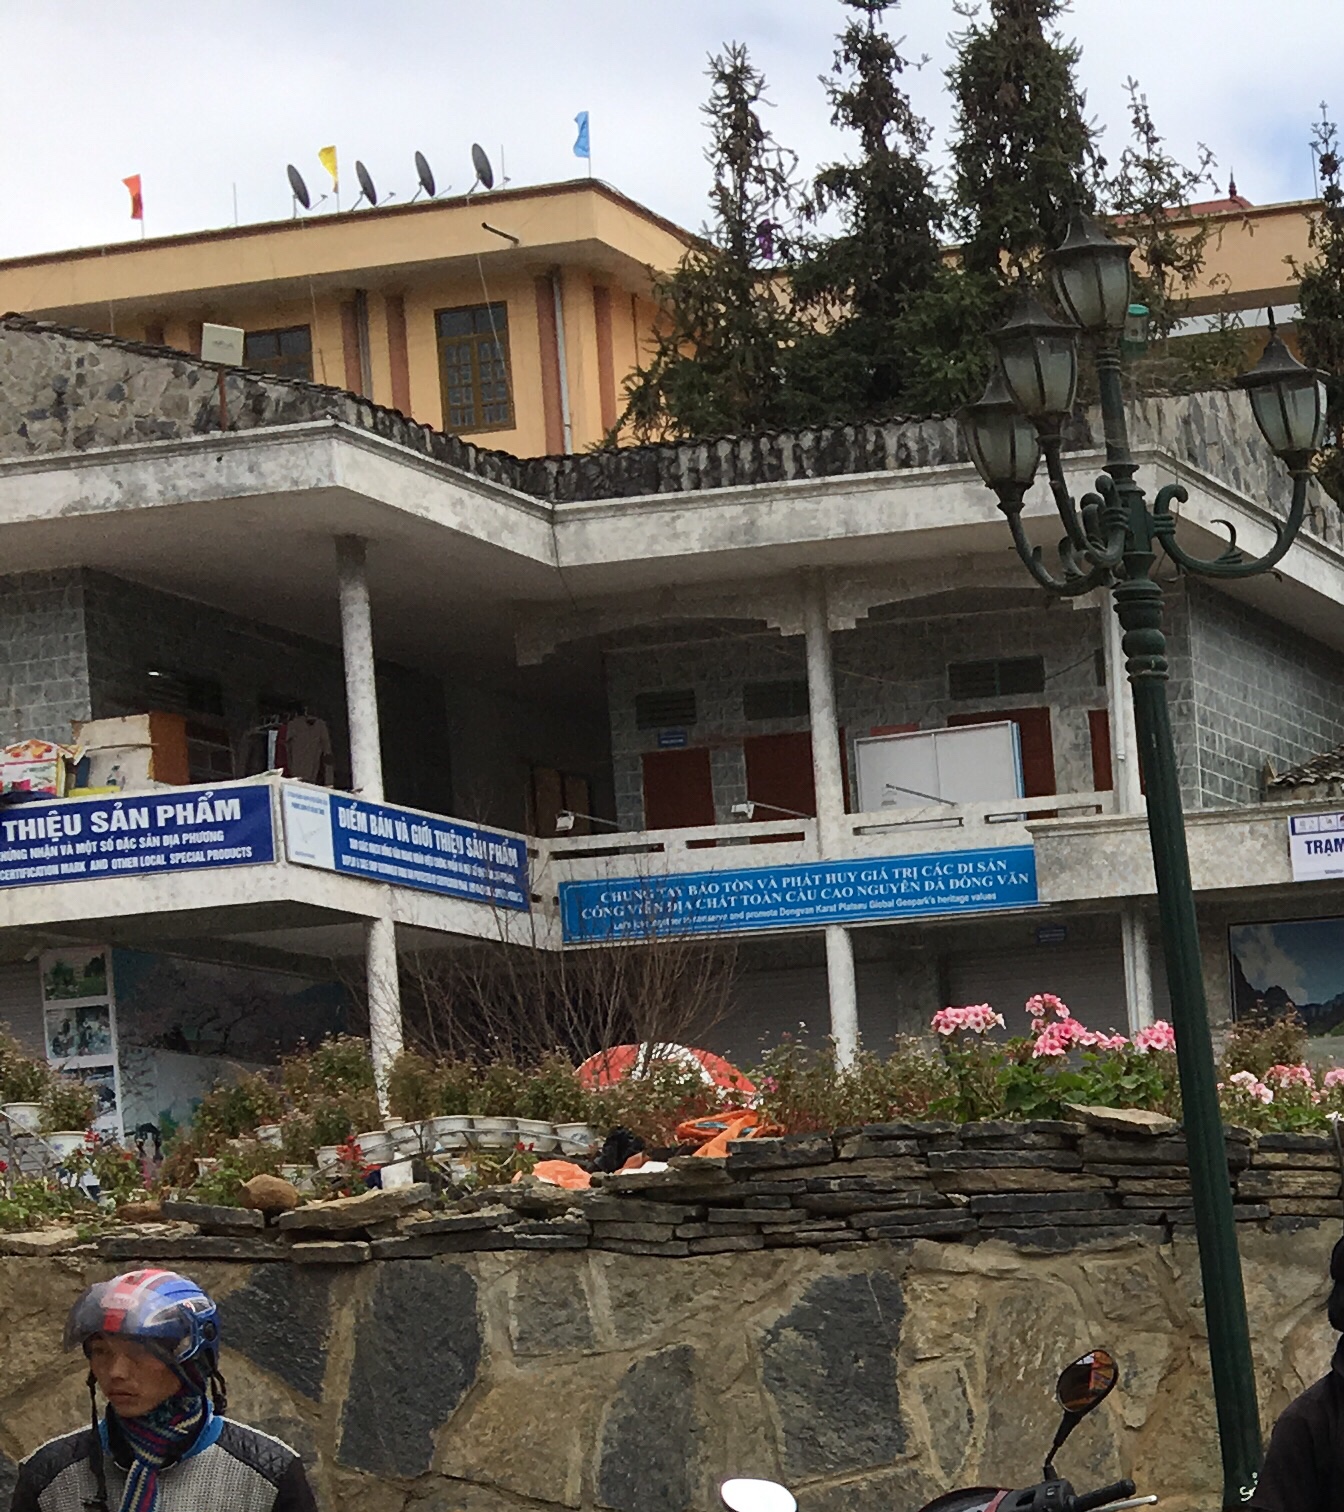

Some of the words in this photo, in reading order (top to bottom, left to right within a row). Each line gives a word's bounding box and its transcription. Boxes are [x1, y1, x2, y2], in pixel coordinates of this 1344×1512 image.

[2, 810, 81, 842] THIỆU
[91, 802, 149, 832] SẢN
[157, 791, 241, 827] PHẨM
[338, 802, 368, 831] ĐIỂM
[370, 811, 393, 838] BÁN
[395, 816, 410, 842] VÀ
[411, 820, 433, 848] GIỚI
[61, 861, 86, 874] MARK
[112, 856, 138, 869] OTHER
[140, 853, 166, 867] LOCAL
[170, 850, 205, 864] SPECIAL
[207, 846, 252, 861] PRODUCTS
[688, 881, 719, 895] BẢO
[722, 876, 754, 892] TỒN
[757, 875, 778, 889] VÀ
[782, 870, 822, 888] PHÁT
[826, 871, 858, 884] HUY
[860, 867, 888, 881] GIÁ
[892, 867, 918, 880] TRỊ
[922, 861, 953, 876] CÁC
[958, 863, 974, 874] DI
[977, 858, 1007, 872] SẢN
[581, 902, 625, 920] CÔNG
[695, 894, 738, 910] CHẤT
[740, 892, 783, 905] TOÀN
[785, 887, 817, 902] CẦU
[820, 888, 854, 900] CAO
[857, 880, 920, 897] NGUYÊN
[950, 874, 994, 889] ĐỒNG
[997, 871, 1029, 885] VĂN
[730, 911, 744, 920] and
[746, 908, 778, 920] promote
[816, 903, 837, 914] Karst
